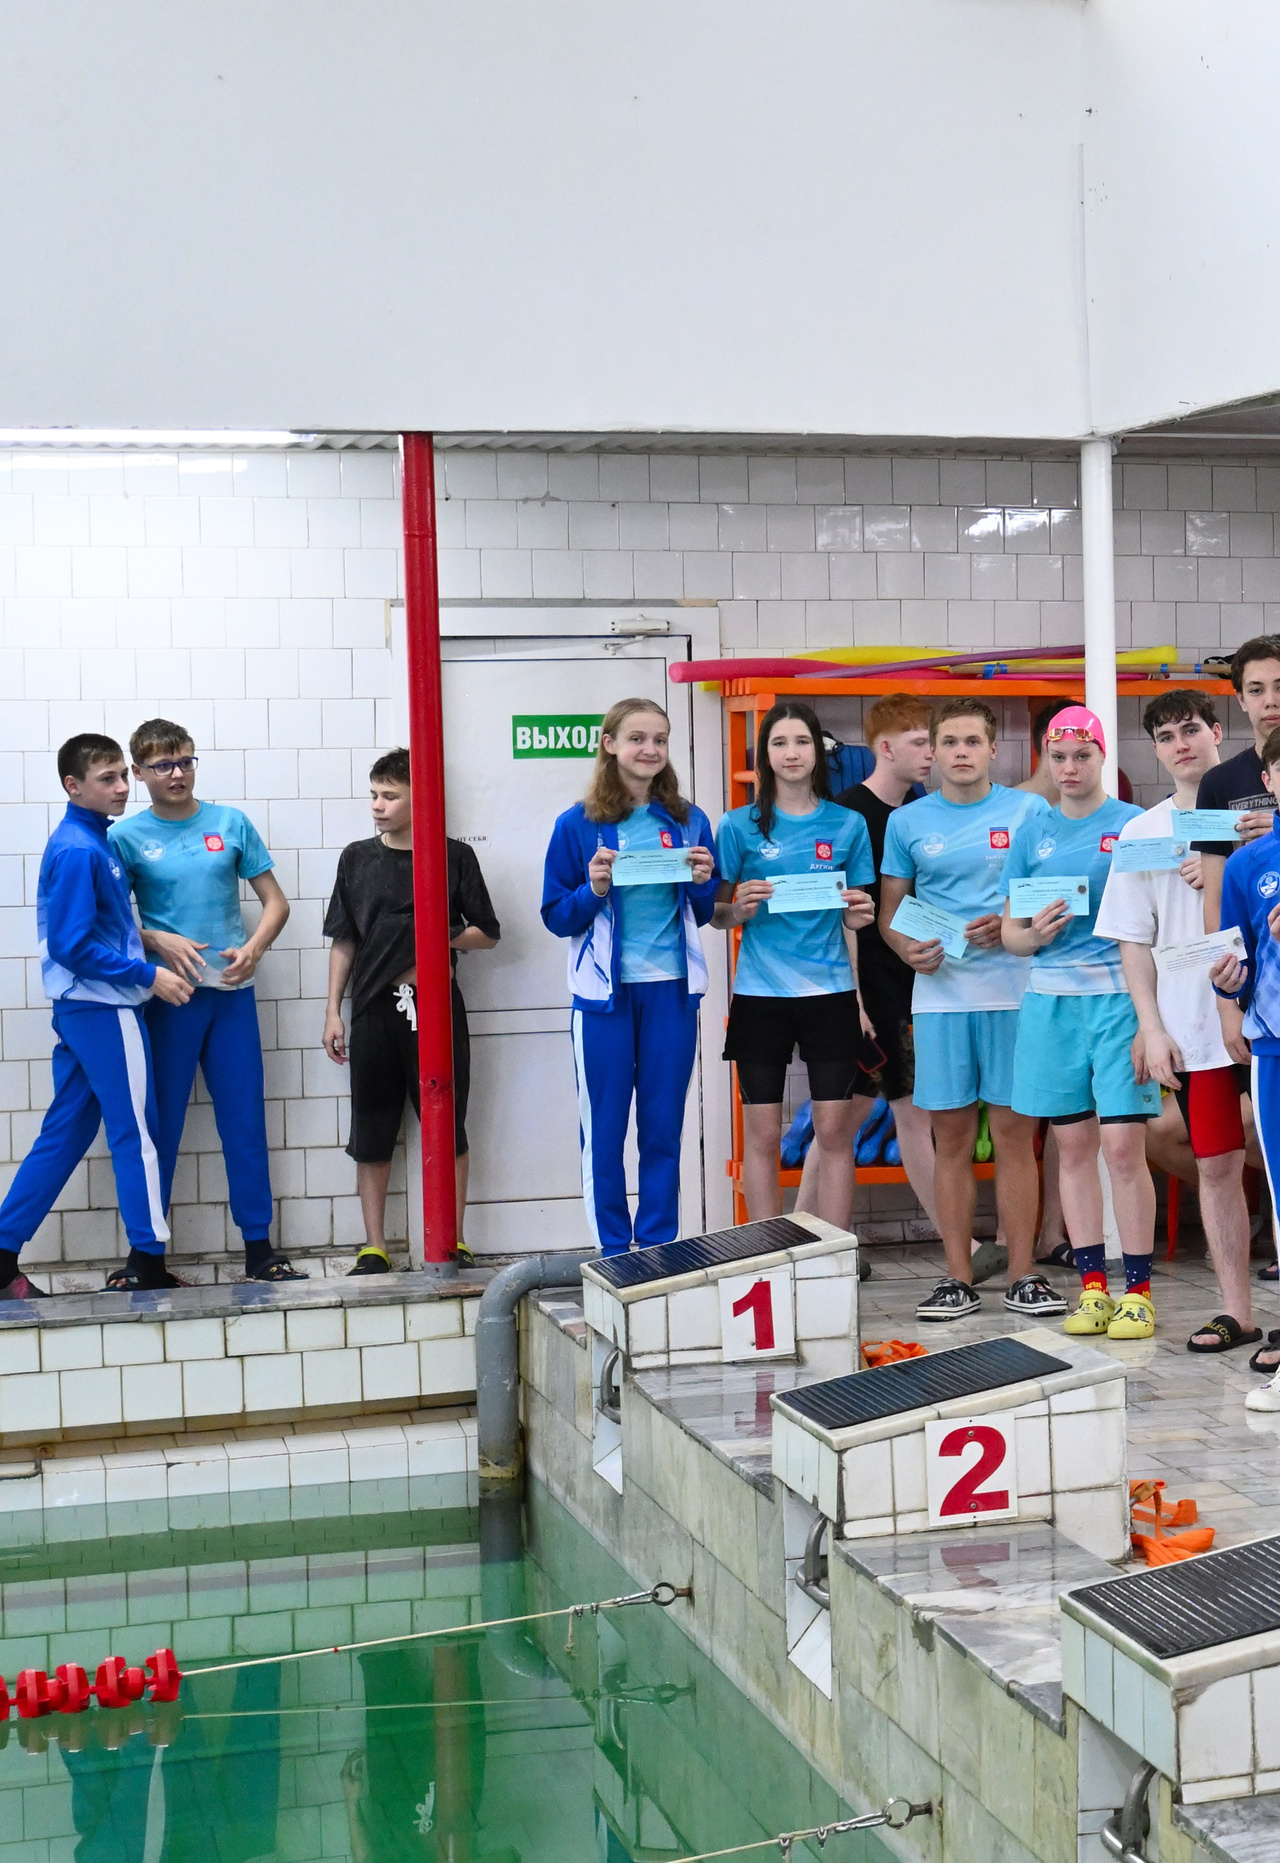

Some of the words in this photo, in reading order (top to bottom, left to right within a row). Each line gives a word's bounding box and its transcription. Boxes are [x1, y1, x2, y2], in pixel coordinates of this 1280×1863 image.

[516, 725, 602, 752] ВЫХОД
[732, 1280, 775, 1350] 1
[939, 1425, 1009, 1517] 2
